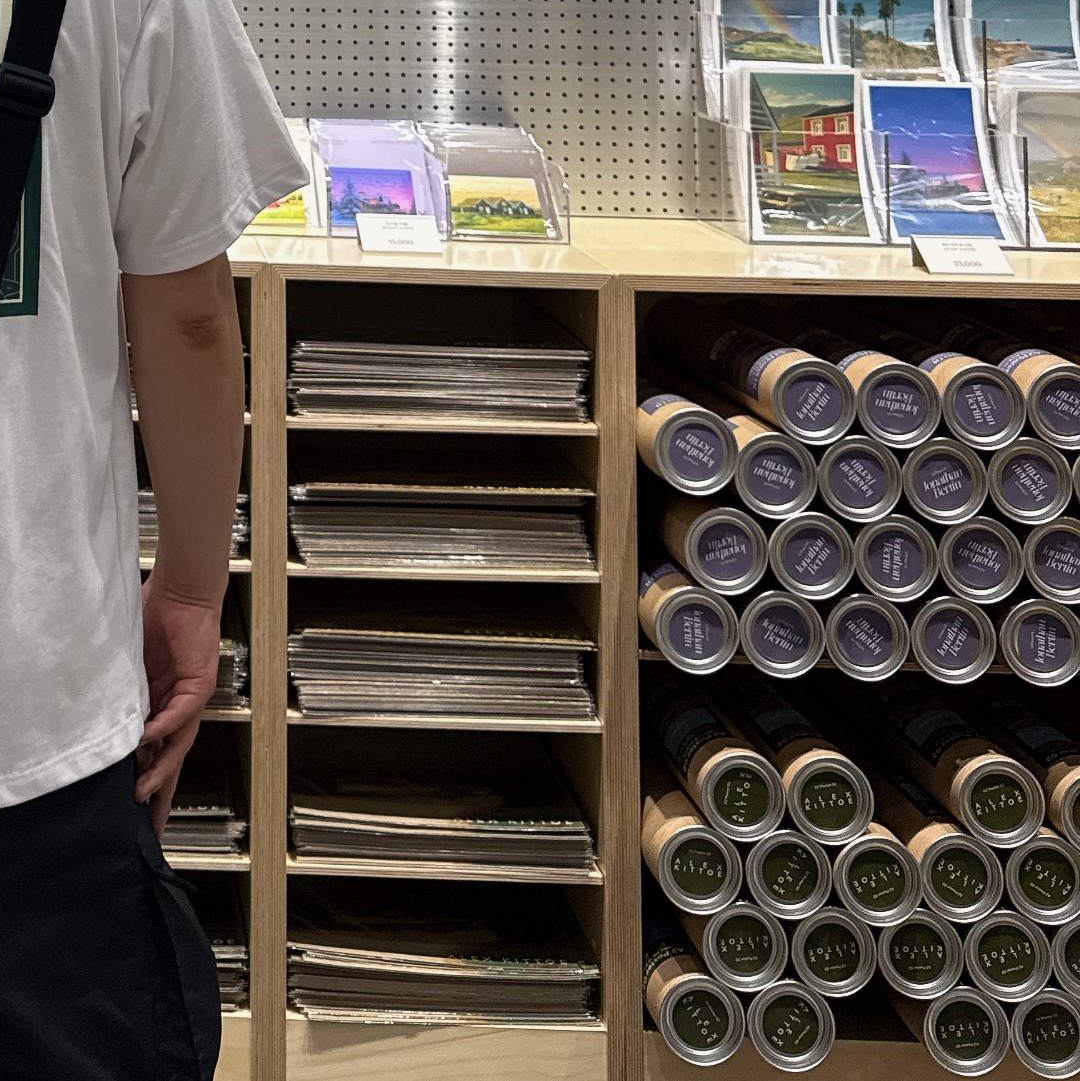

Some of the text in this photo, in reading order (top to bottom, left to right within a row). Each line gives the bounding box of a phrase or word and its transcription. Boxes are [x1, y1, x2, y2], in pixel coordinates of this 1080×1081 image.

[738, 774, 752, 822] KITTOE
[805, 798, 853, 811] KITTOE
[976, 795, 1024, 816] KITTOE
[674, 865, 723, 878] KITTOE
[772, 849, 803, 891] KITTOE
[853, 863, 898, 888] KITTOE
[940, 859, 984, 889] KITTOE
[1027, 859, 1072, 891] KITTOE
[720, 935, 769, 946] KITTOE
[807, 942, 856, 956] KITTOE
[894, 945, 943, 953] KITTOE
[982, 942, 1030, 961] KITTOE
[682, 998, 713, 1044] KITTOE
[771, 1001, 805, 1042] KITTOE
[940, 1021, 989, 1033] KITTOE
[1027, 1028, 1076, 1044] KITTOE
